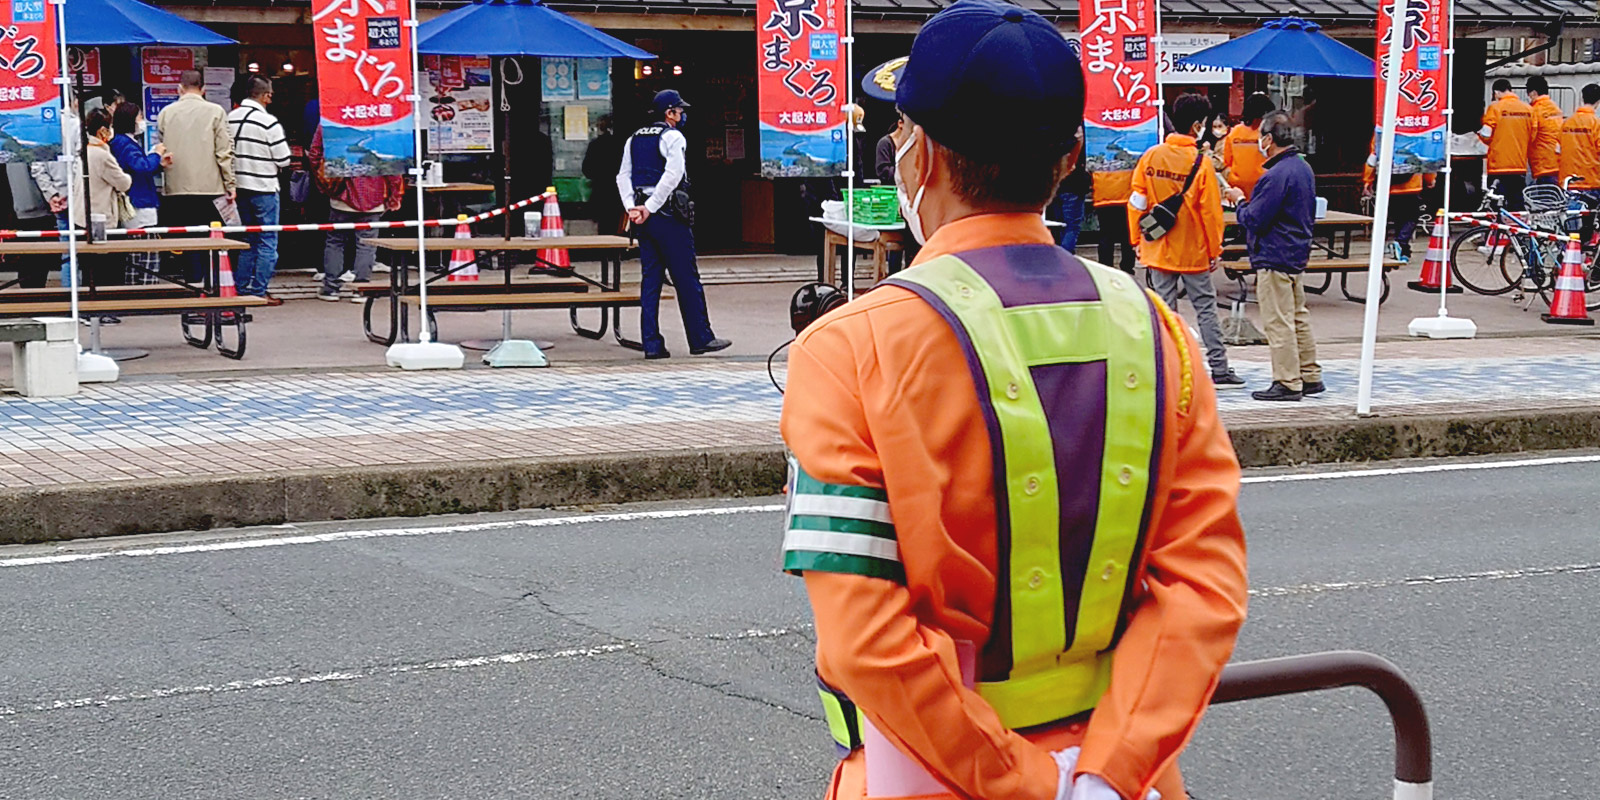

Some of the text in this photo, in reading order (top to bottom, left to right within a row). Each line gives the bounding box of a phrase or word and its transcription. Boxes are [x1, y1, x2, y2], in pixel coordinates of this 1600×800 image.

[368, 27, 399, 38] 超大型
[341, 104, 393, 119] 大起水産
[1102, 109, 1141, 121] 大起水産
[779, 111, 827, 125] 大起水産
[635, 126, 663, 135] POLICE
